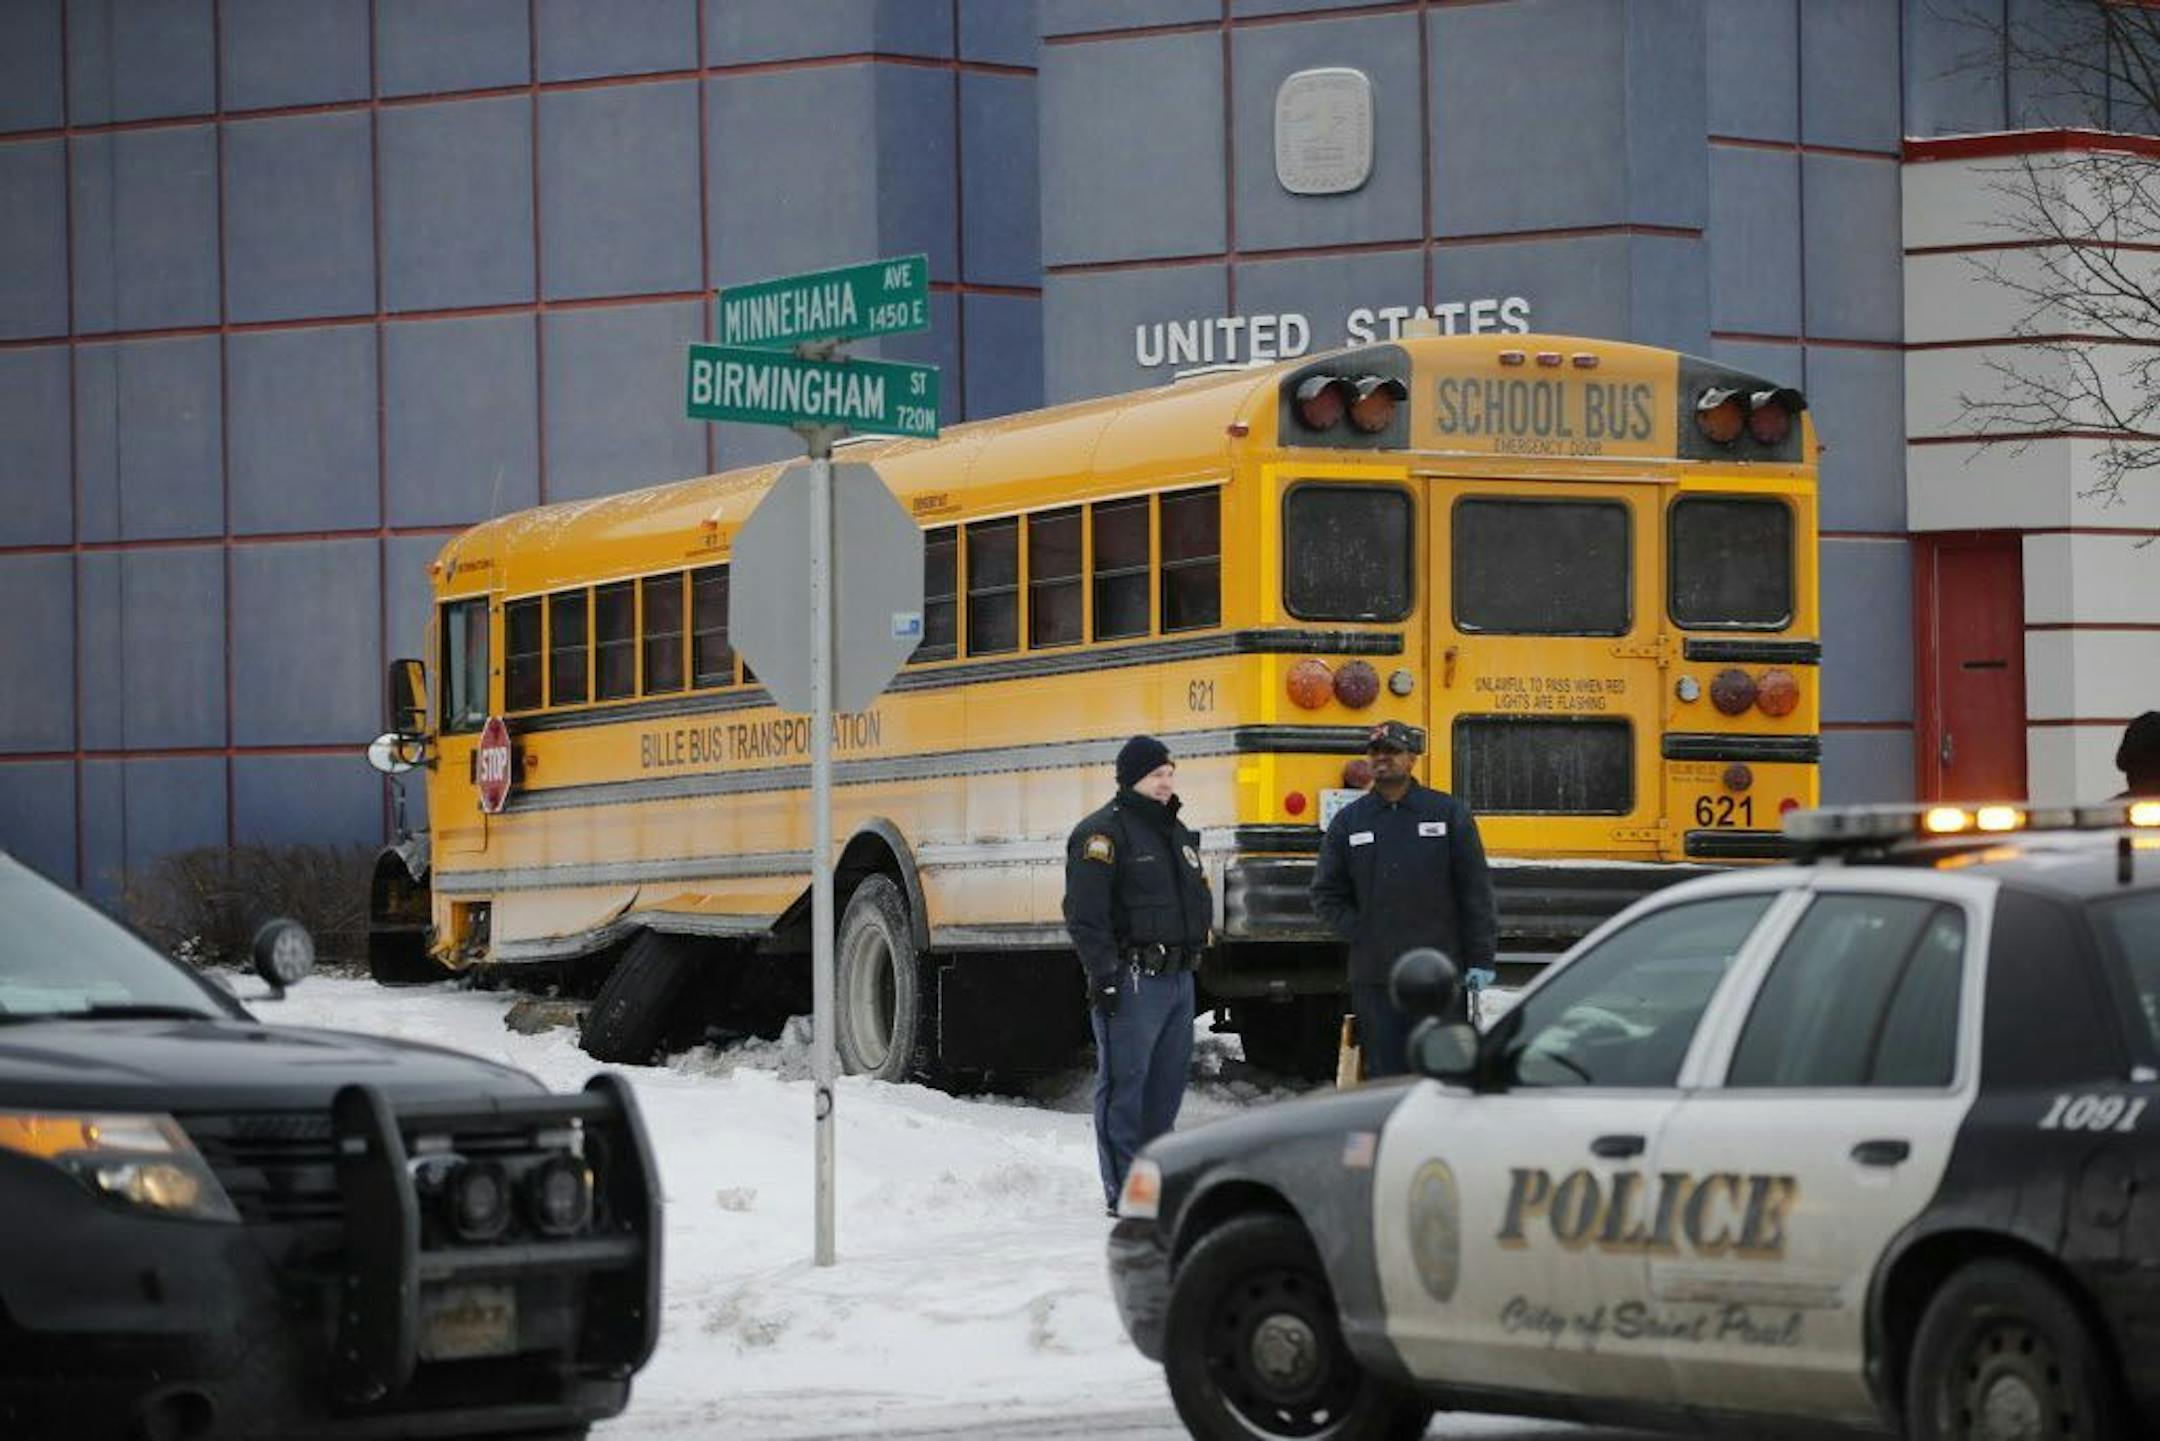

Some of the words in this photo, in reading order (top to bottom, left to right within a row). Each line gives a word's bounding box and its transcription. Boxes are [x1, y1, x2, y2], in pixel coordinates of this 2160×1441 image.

[883, 264, 912, 290] AVE
[725, 281, 857, 344] MINNEHAHA
[868, 304, 908, 331] 1450
[914, 301, 923, 325] E
[1136, 313, 1311, 367] UNITED
[692, 359, 885, 420] BIRMINGHAM
[911, 372, 927, 395] ST
[896, 406, 935, 431] 720N
[1438, 377, 1573, 438] SCHOOL
[1585, 382, 1652, 441] BUS
[1494, 438, 1563, 457] EMERGENCY
[1568, 440, 1602, 457] DOOR
[1189, 679, 1214, 712] 621
[1475, 676, 1527, 693] UNLAWFUL
[1530, 677, 1543, 693] TO
[1546, 678, 1570, 694] PASS
[1573, 679, 1603, 694] WHEN
[1605, 679, 1625, 694] RED
[1494, 694, 1530, 710] LIGHTS
[1533, 695, 1553, 710] ARE
[1556, 696, 1606, 710] FLASHING
[641, 730, 685, 768] BILLE
[690, 726, 723, 763] BUS
[728, 711, 881, 760] TRANSPOATION
[482, 745, 508, 782] STOP
[1696, 795, 1752, 828] 621
[2038, 1093, 2148, 1132] 1091
[1495, 1167, 1799, 1260] POLICE
[1501, 1296, 1567, 1351] City
[1571, 1305, 1605, 1353] of
[1612, 1300, 1706, 1343] Saint
[1717, 1302, 1801, 1346] Paul
